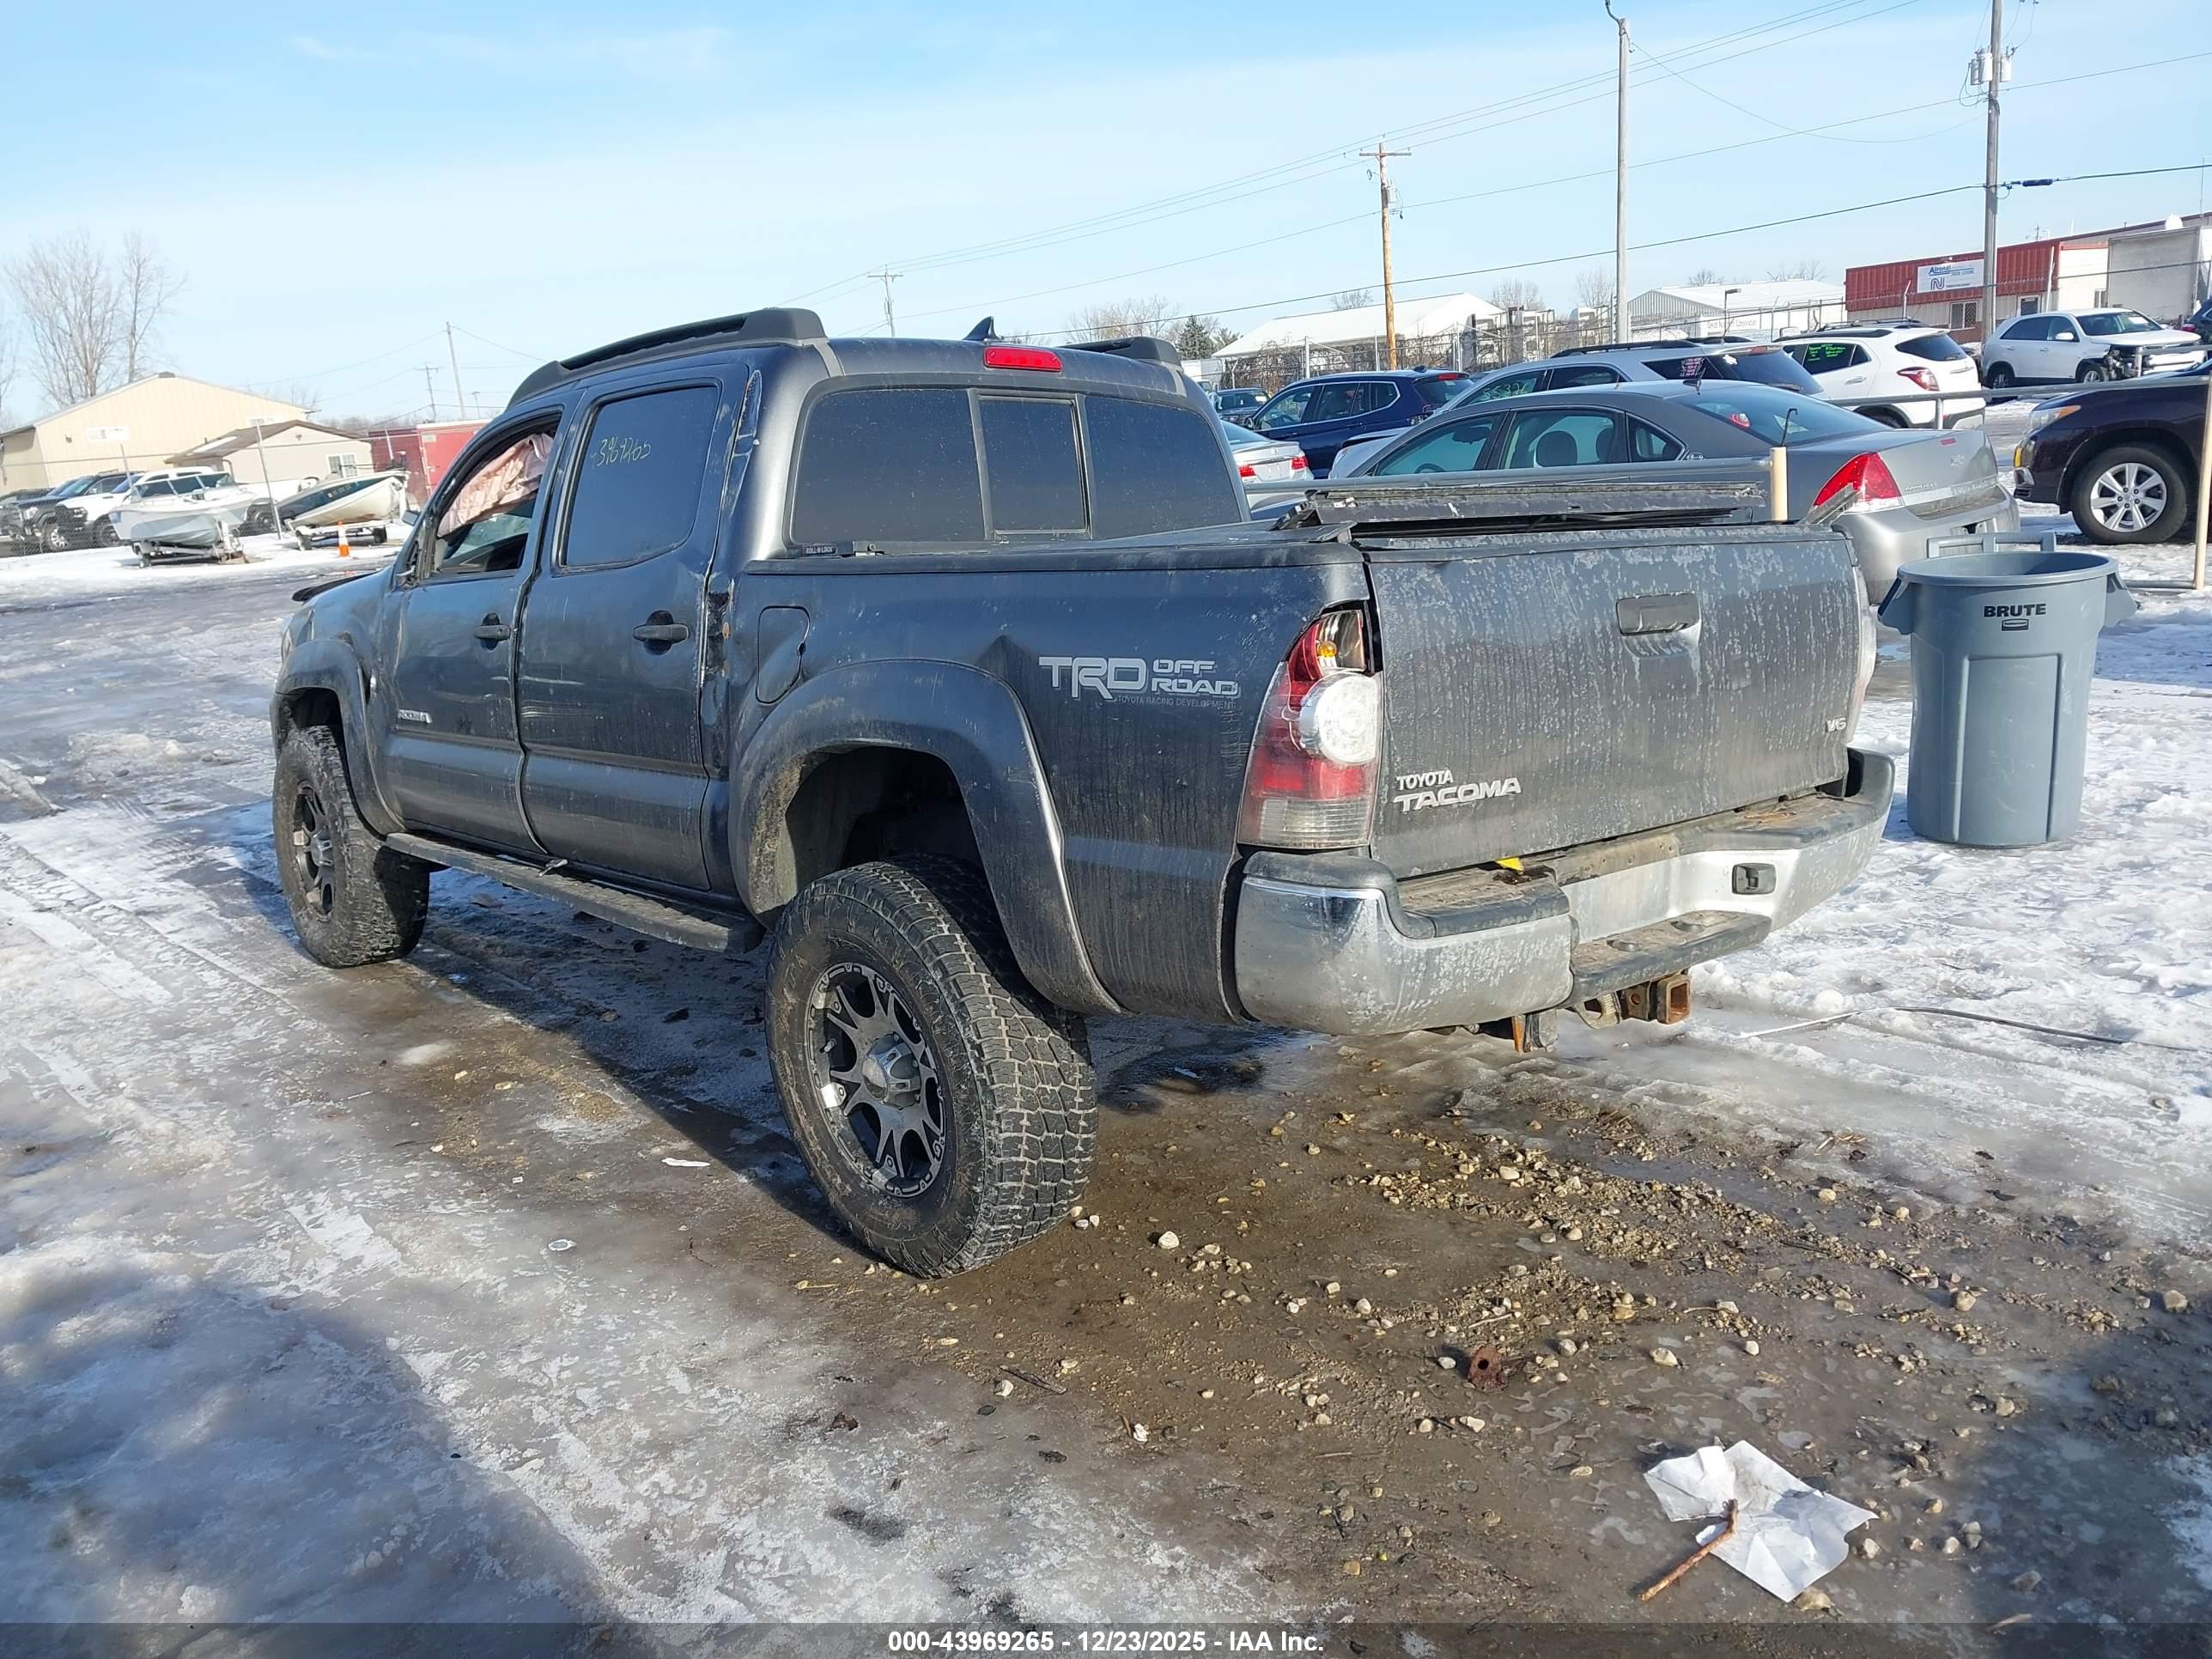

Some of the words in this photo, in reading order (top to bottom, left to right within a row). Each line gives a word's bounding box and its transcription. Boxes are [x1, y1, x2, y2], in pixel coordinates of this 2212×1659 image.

[1984, 604, 2047, 617] BRUTE
[1153, 659, 1215, 674] OFF
[1039, 657, 1147, 700] TRD
[1152, 678, 1237, 696] ROAD
[1117, 695, 1144, 703] TOYOTA
[1146, 696, 1173, 706] RACING
[1826, 718, 1846, 732] V6
[1396, 769, 1454, 791] TOYOTA
[1394, 778, 1522, 812] TACOMA
